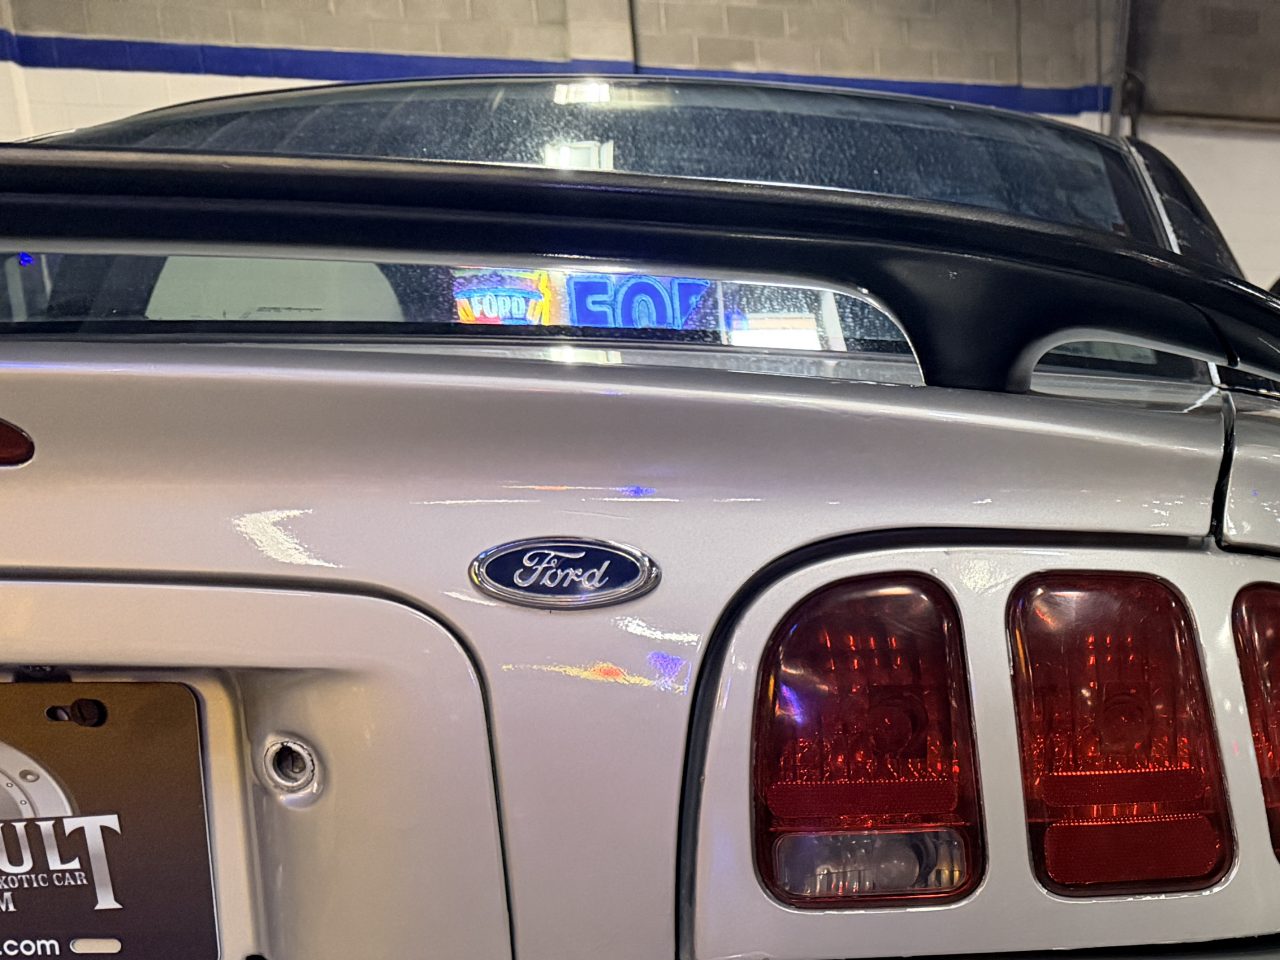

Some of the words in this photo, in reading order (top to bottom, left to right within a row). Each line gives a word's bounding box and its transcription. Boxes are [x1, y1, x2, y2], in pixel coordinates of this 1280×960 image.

[470, 294, 527, 317] FORD
[513, 550, 609, 590] Ford
[52, 871, 89, 886] CAR
